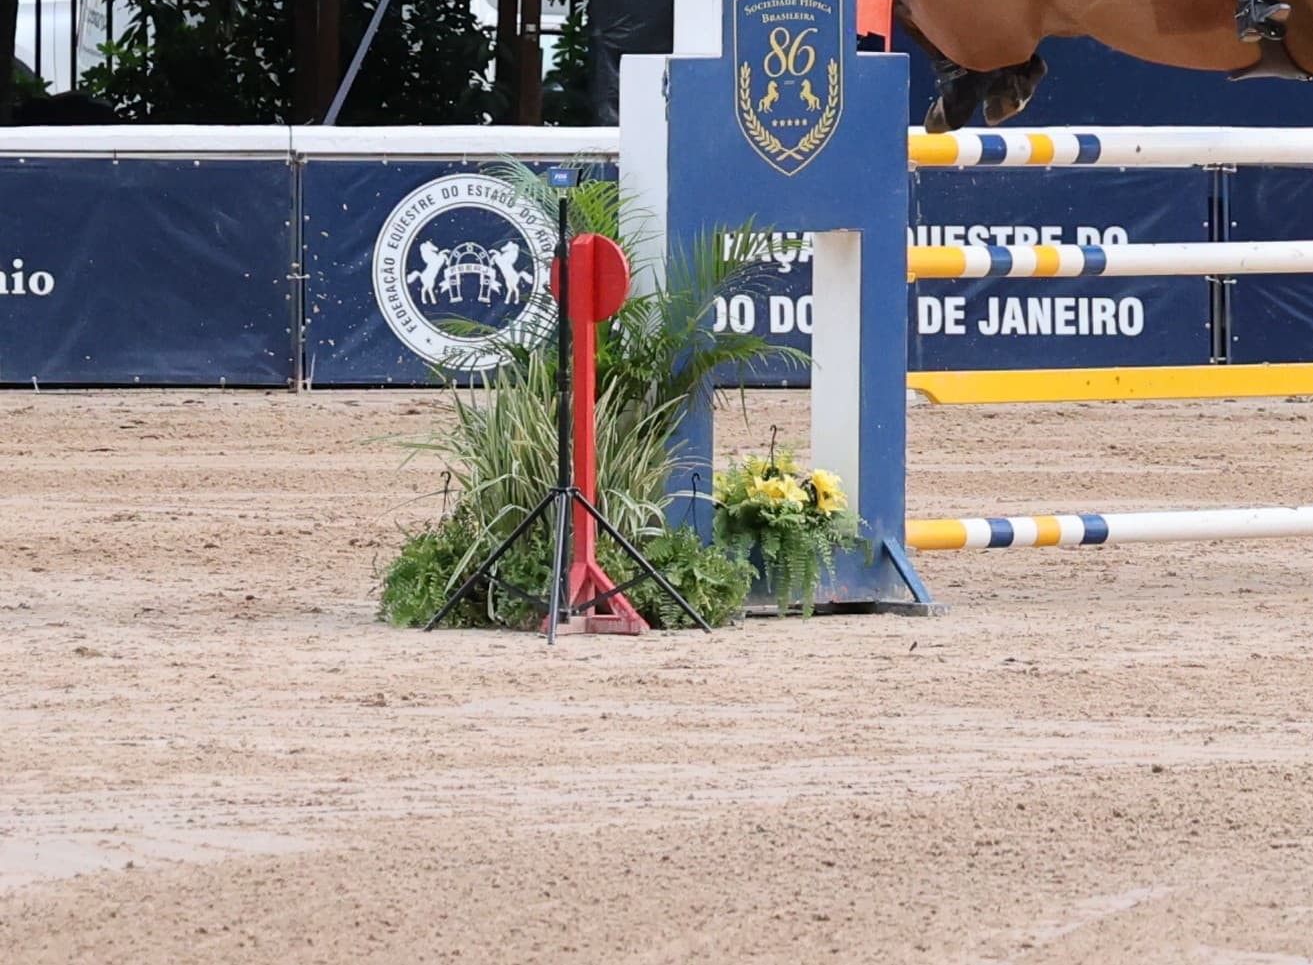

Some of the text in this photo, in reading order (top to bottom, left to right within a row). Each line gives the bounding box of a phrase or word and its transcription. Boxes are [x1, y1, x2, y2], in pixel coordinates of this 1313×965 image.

[761, 12, 815, 23] BRASILEIRA
[763, 26, 819, 78] 86
[383, 256, 418, 334] FEDERAÇÃO
[441, 185, 459, 200] DO
[519, 207, 536, 225] DO
[917, 297, 966, 334] DE
[978, 297, 1144, 336] JANEIRO
